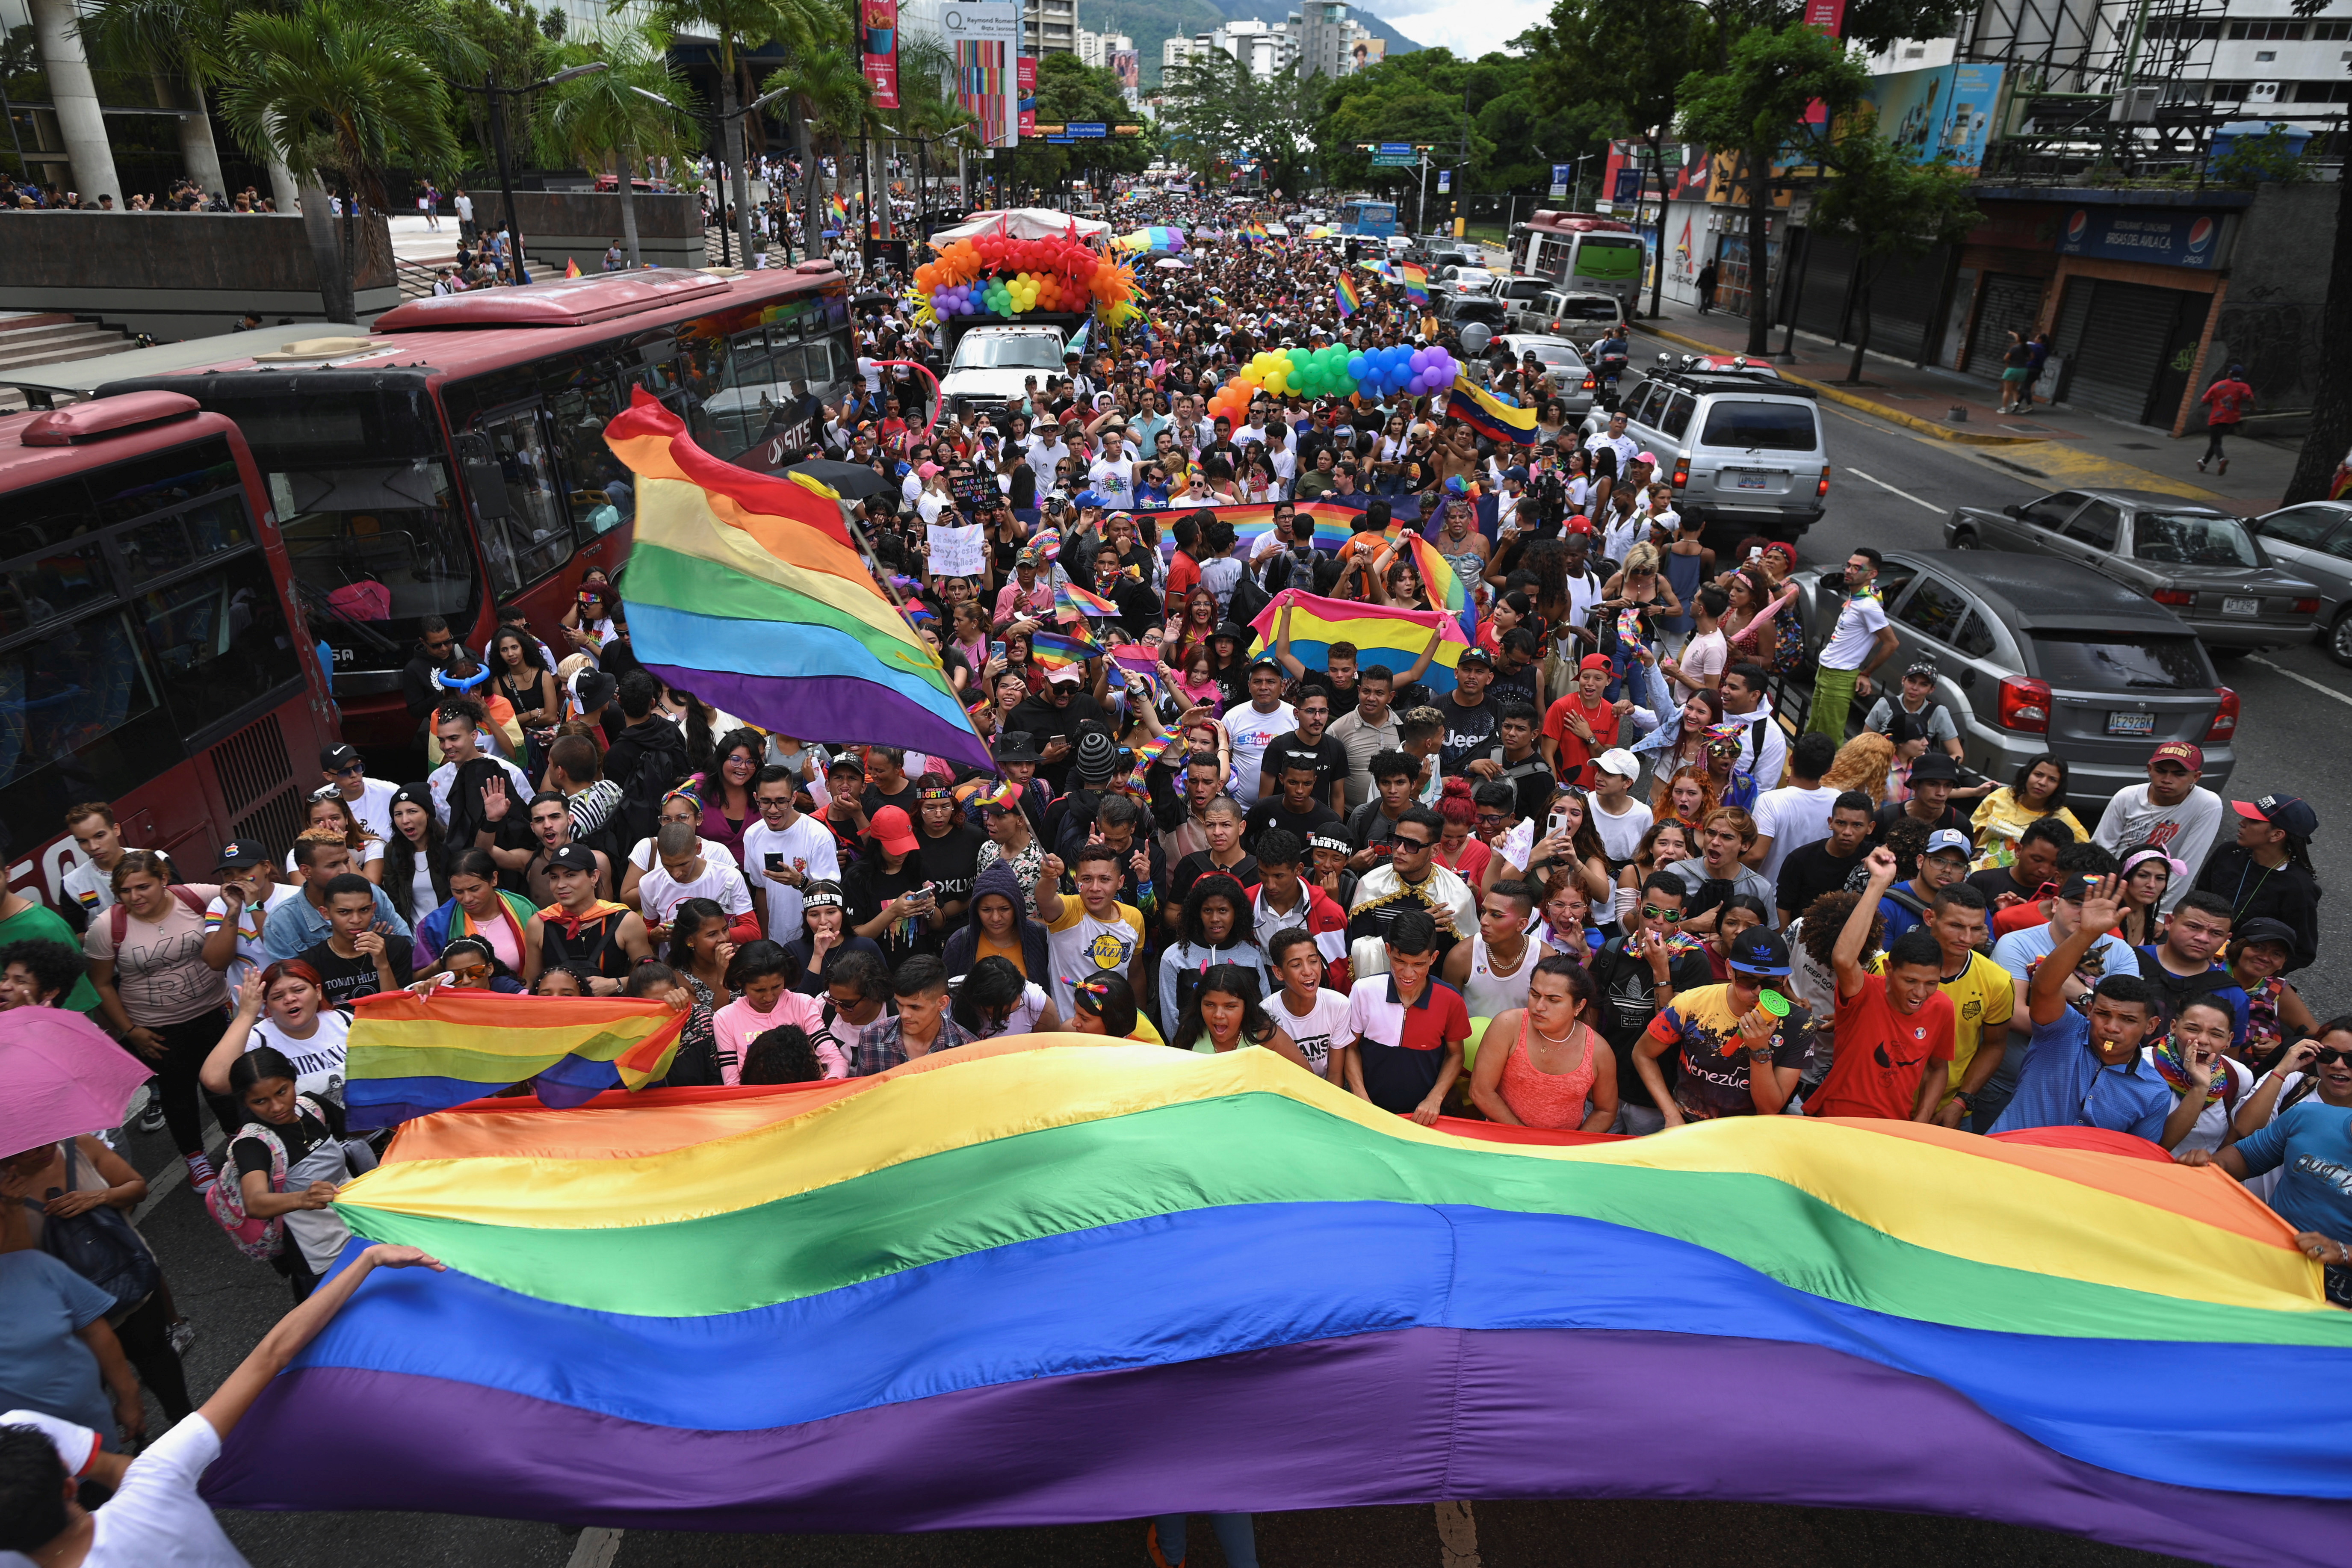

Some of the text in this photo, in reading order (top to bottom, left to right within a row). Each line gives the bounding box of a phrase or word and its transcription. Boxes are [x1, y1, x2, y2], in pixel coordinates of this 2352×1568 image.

[2105, 232, 2127, 244] BRISAS
[2127, 233, 2138, 245] DEL
[2139, 234, 2159, 247] AVILA
[952, 478, 975, 486] Porque
[984, 474, 997, 482] odio
[954, 487, 997, 498] nadie menos
[971, 494, 987, 503] GAY
[933, 544, 951, 558] Gay
[1516, 685, 1534, 699] MEN
[2110, 716, 2153, 729] AE292BK
[2160, 747, 2188, 759] PUMA
[1083, 941, 1131, 963] LAKERS
[1803, 963, 1822, 980] KEEP
[325, 976, 355, 990] TOMMY
[1299, 1039, 1329, 1057] ANS
[1686, 1054, 1751, 1090] Venezue
